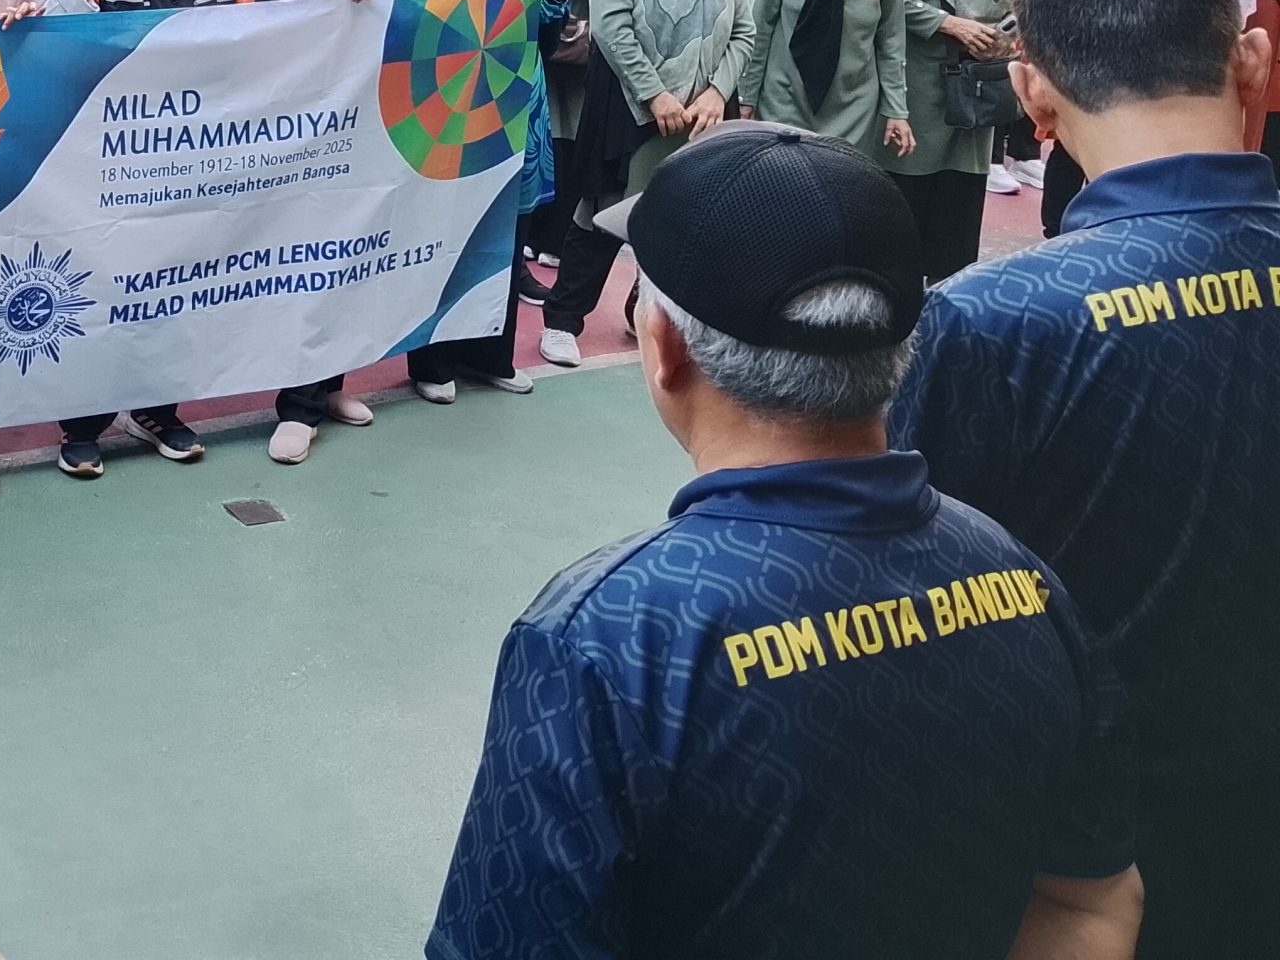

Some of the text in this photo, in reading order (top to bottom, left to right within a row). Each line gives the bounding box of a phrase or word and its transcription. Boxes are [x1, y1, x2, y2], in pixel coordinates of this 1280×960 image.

[102, 89, 202, 123] MILAD
[101, 106, 360, 159] MUHAMMADIYAH
[101, 137, 353, 183] 18 November 1912-18 November 2025
[99, 162, 350, 208] Memajukan Kesejahteraan Bangsa
[224, 248, 271, 273] PCM
[277, 229, 391, 266] LENGKONG
[108, 298, 184, 324] MILAD
[190, 258, 371, 311] MUHAMMADIYAH
[375, 252, 398, 275] KE
[1083, 280, 1177, 333] PDM
[1176, 268, 1264, 318] KOTA
[723, 616, 828, 687] PDM
[824, 596, 928, 662] KOTA
